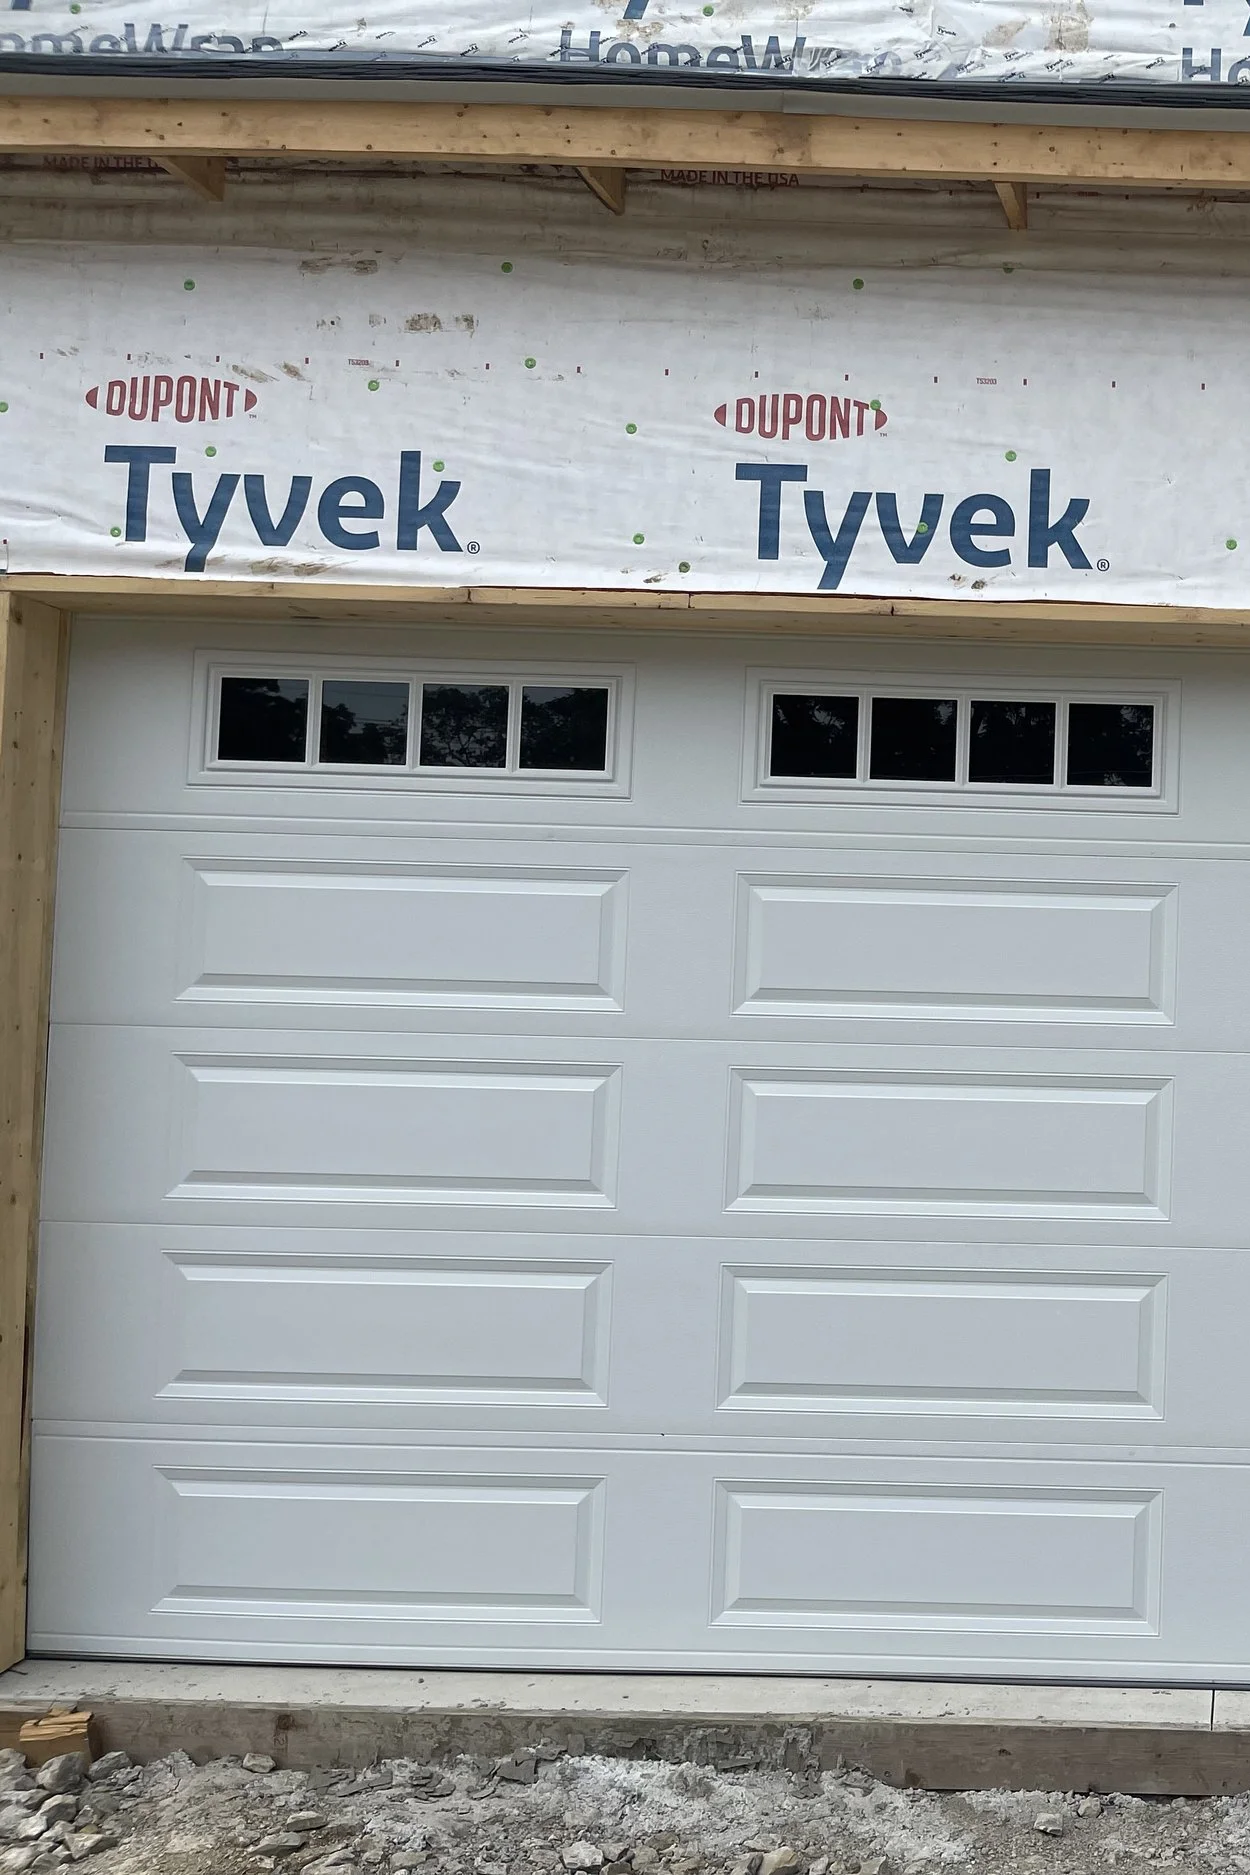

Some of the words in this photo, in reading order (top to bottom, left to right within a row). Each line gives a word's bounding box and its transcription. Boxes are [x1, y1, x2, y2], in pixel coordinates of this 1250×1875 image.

[95, 156, 109, 169] IN
[113, 157, 143, 170] THE
[661, 169, 707, 183] MADE
[712, 170, 728, 184] IN
[735, 171, 763, 185] THE
[768, 172, 799, 186] USA
[106, 375, 240, 422] DUPONT
[735, 394, 870, 441] DUPONT
